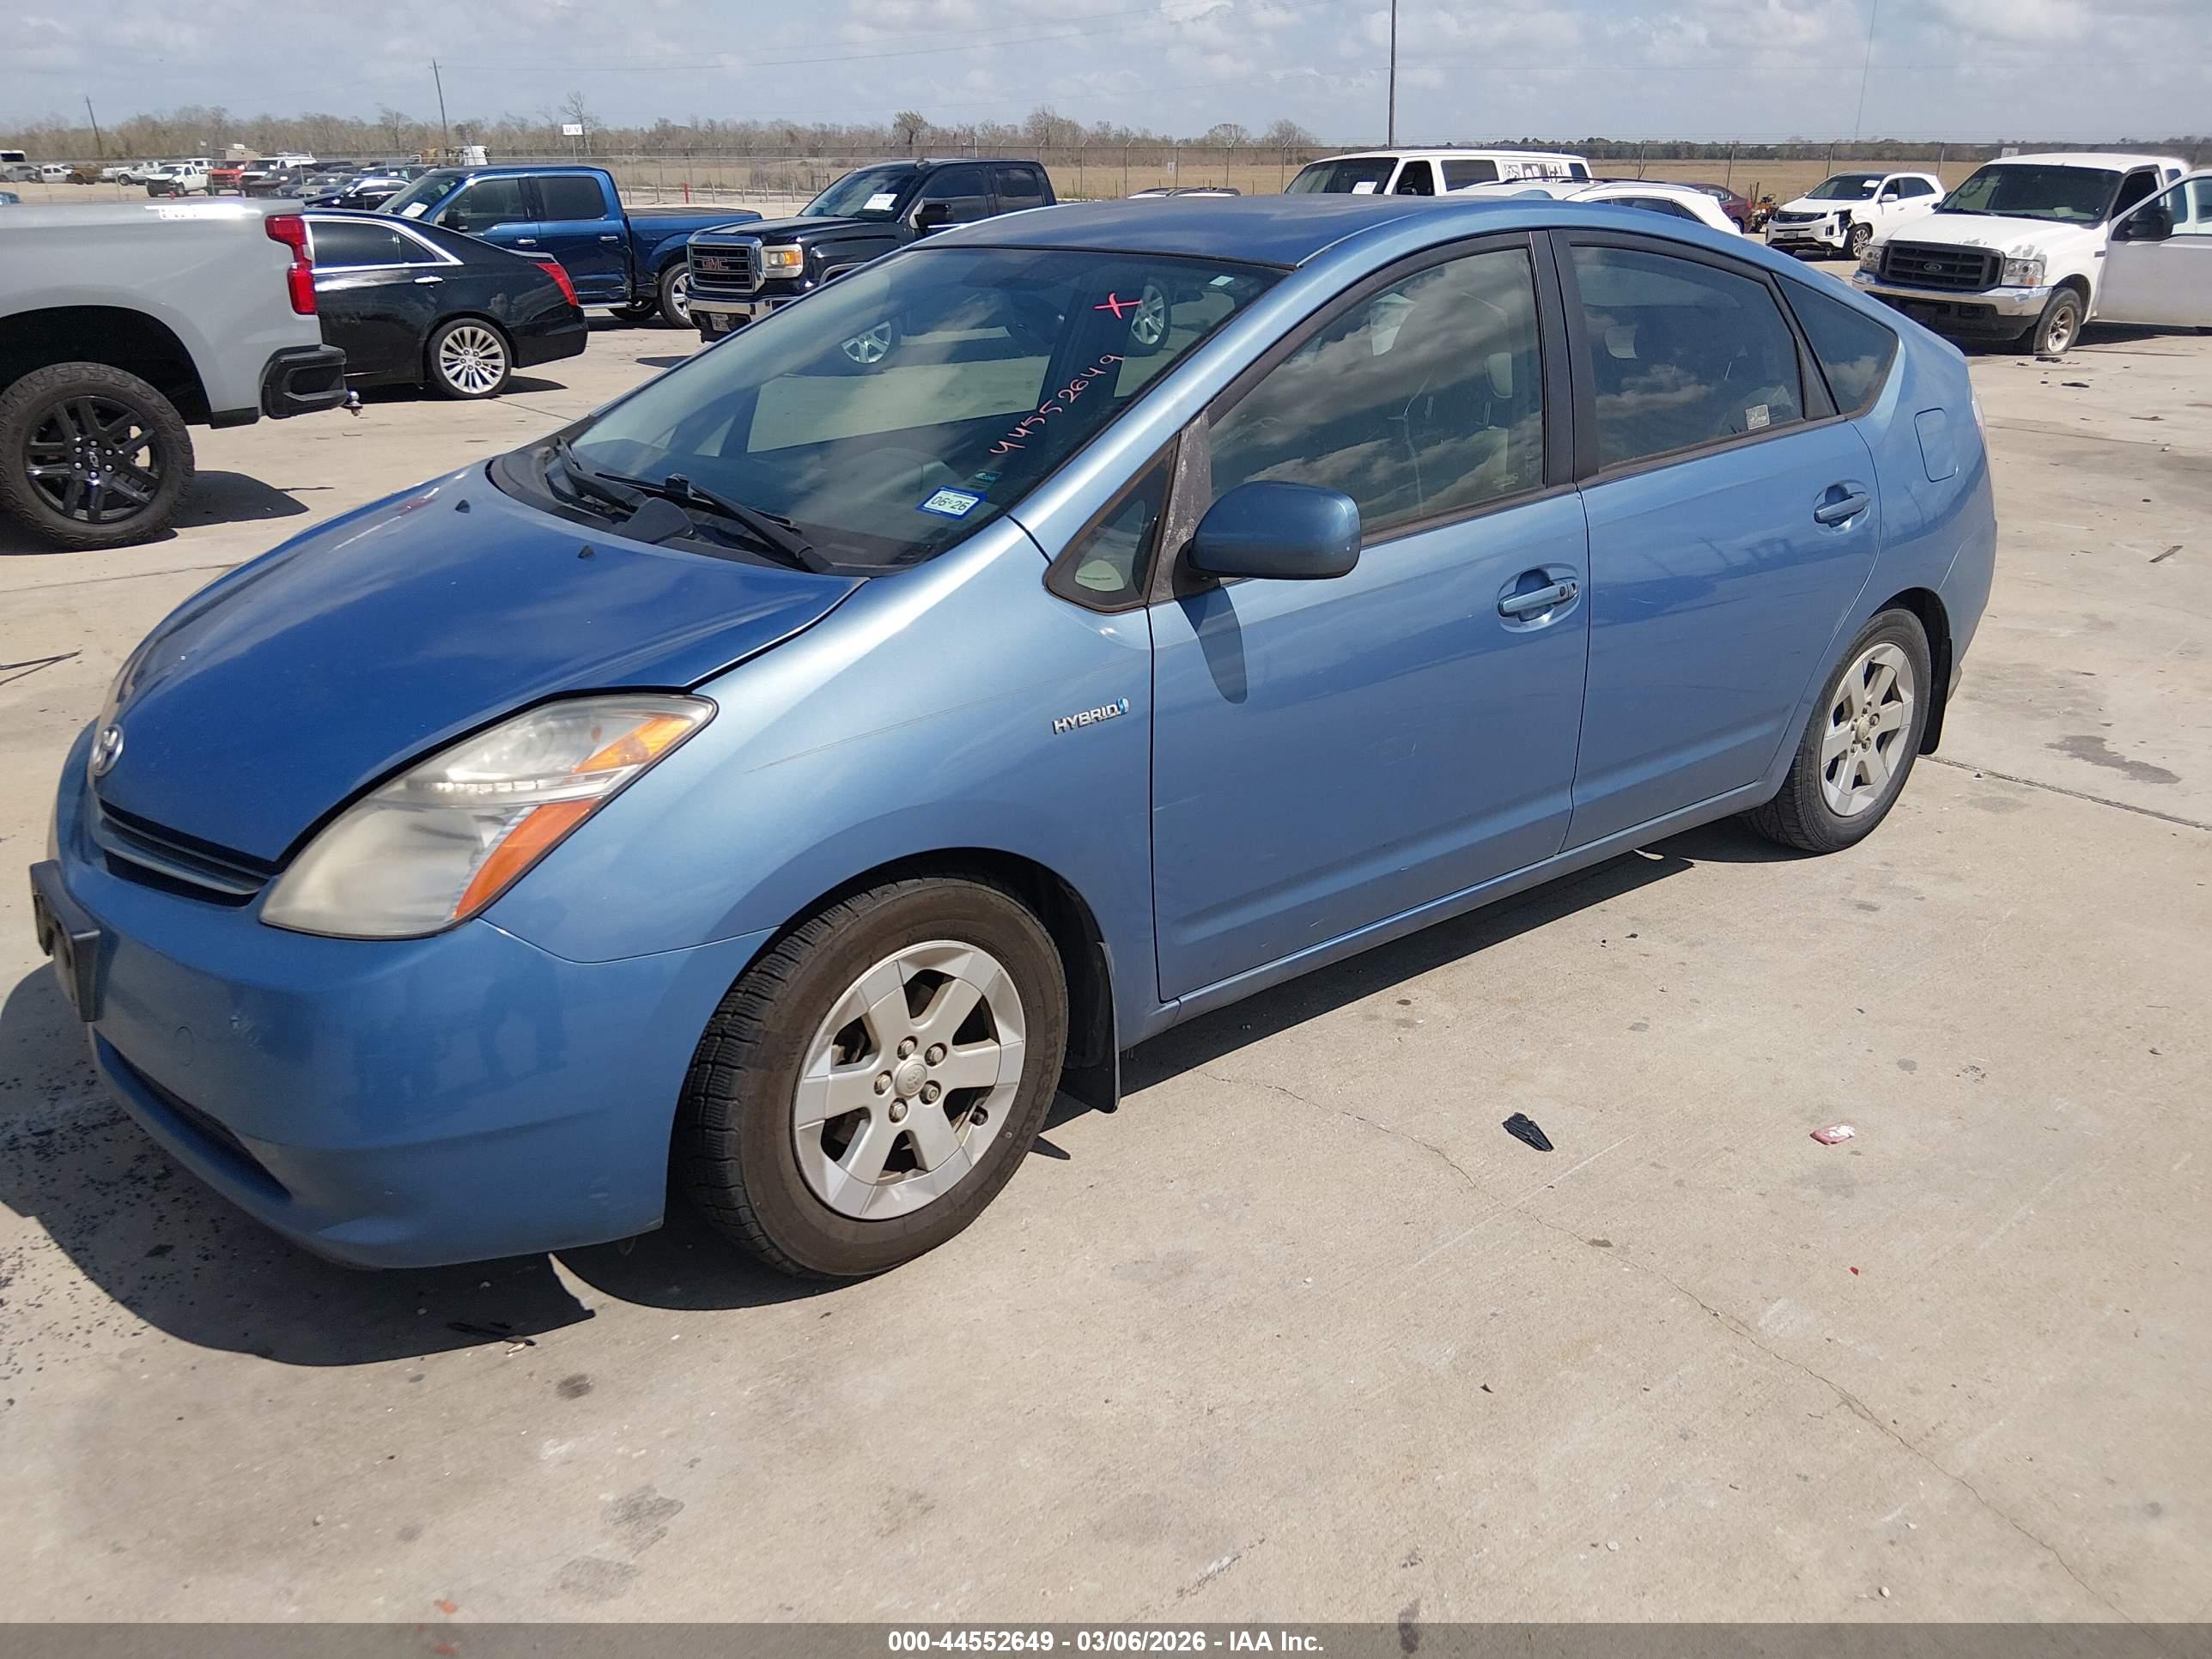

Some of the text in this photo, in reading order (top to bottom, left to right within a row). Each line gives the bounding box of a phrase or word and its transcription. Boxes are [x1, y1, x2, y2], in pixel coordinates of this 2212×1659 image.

[702, 258, 729, 270] GMC
[989, 354, 1125, 454] 44552649
[1052, 703, 1121, 735] HYBRID
